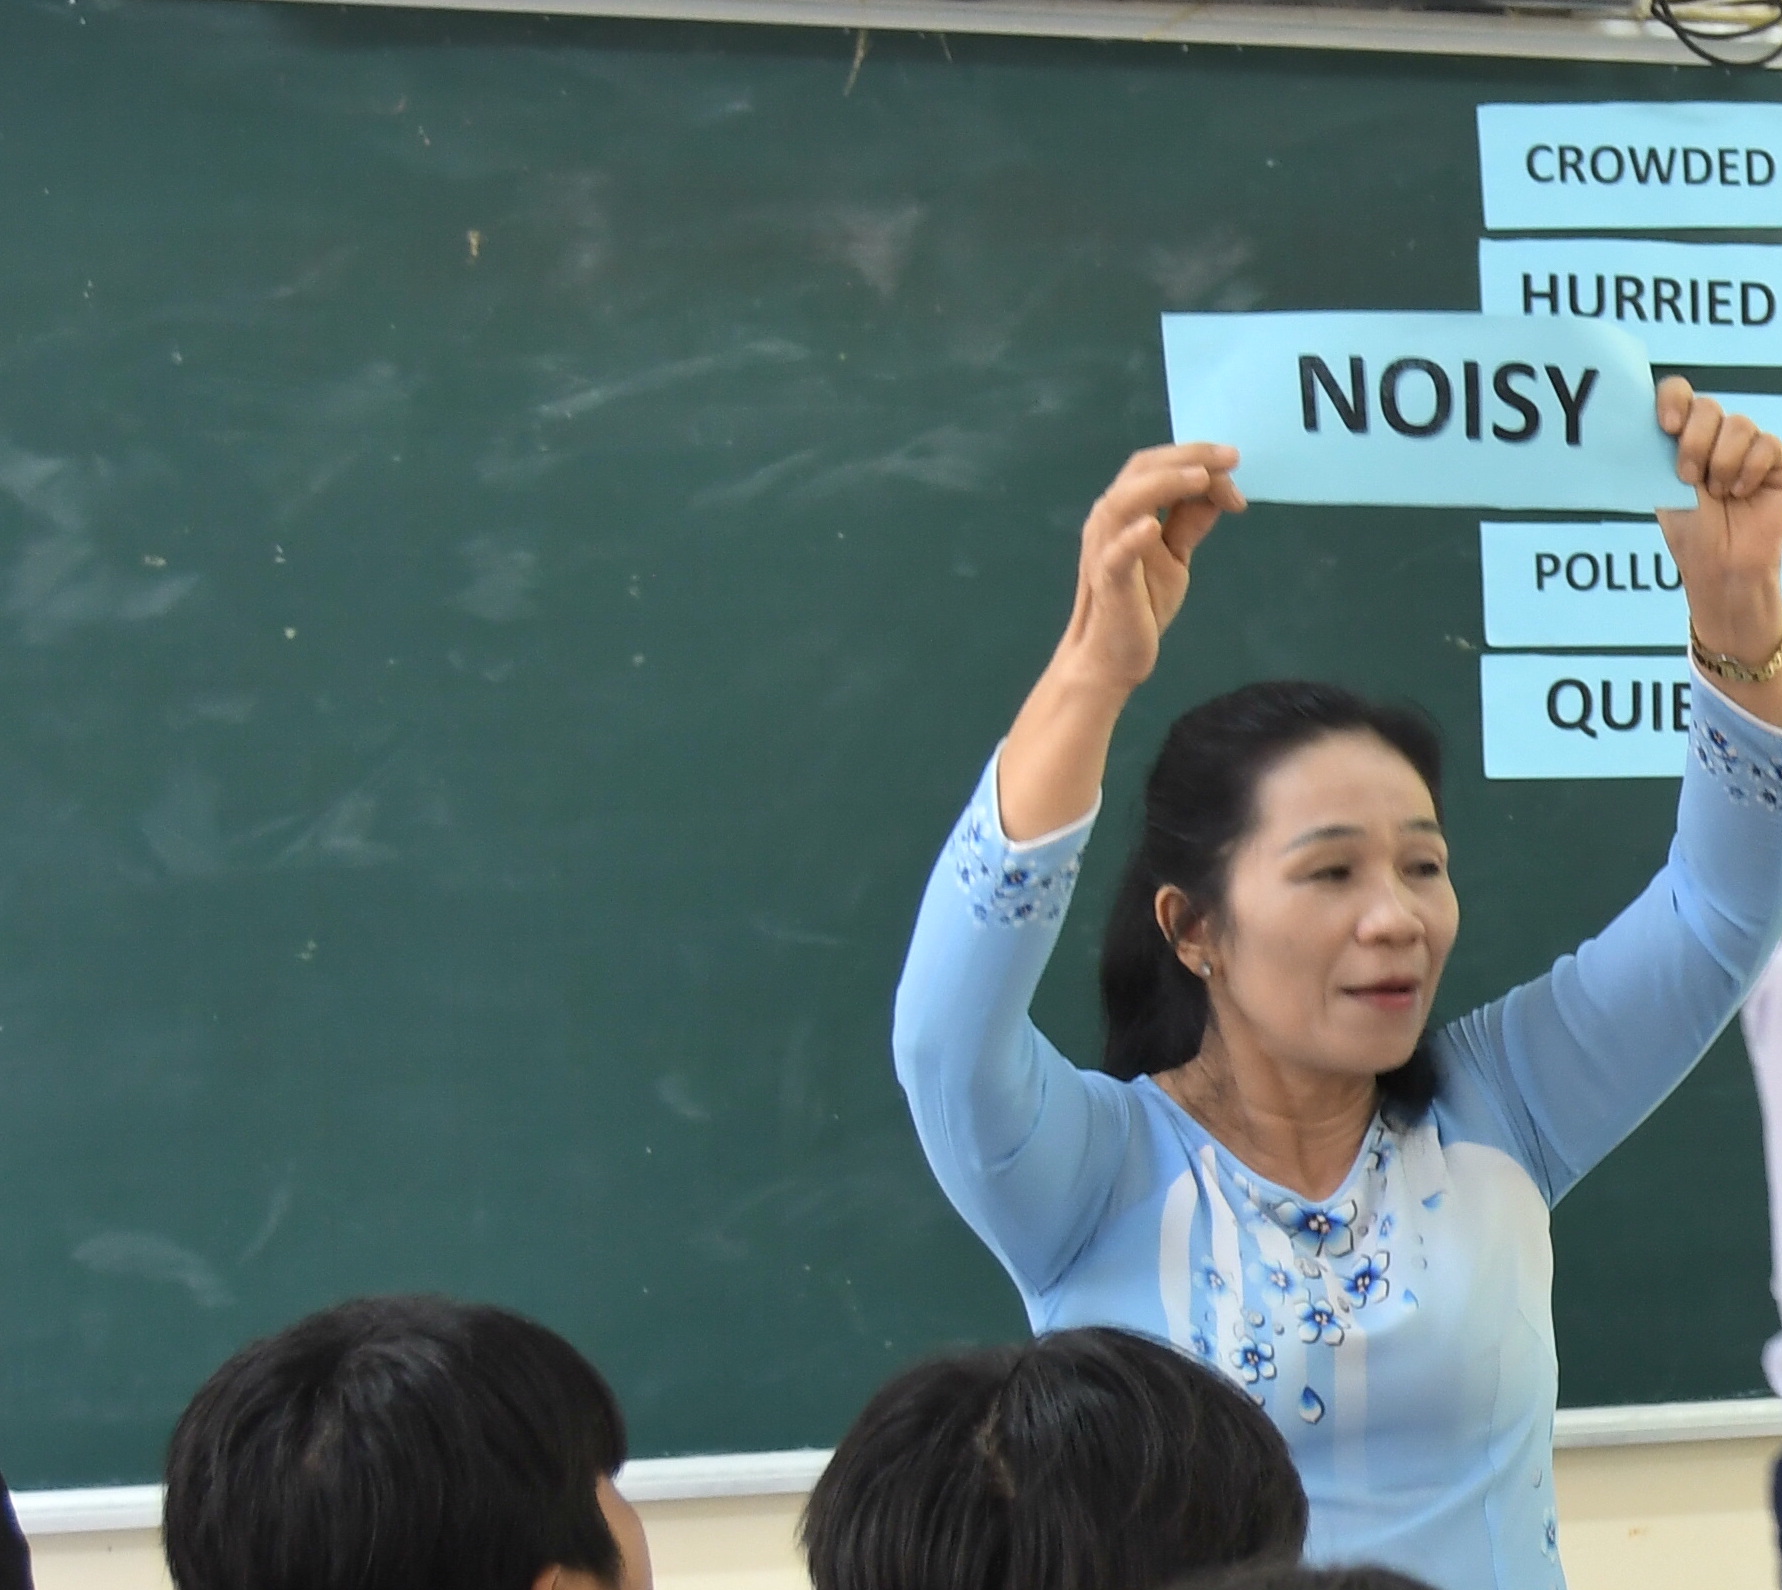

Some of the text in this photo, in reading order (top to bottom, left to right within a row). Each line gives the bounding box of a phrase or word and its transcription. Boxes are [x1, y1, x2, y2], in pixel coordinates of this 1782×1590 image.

[1525, 143, 1776, 186] CROWDED
[1522, 271, 1777, 326] HURRIED
[1298, 354, 1600, 447] NOISY
[1535, 552, 1683, 592] POLLU
[1547, 678, 1691, 739] QUIE
